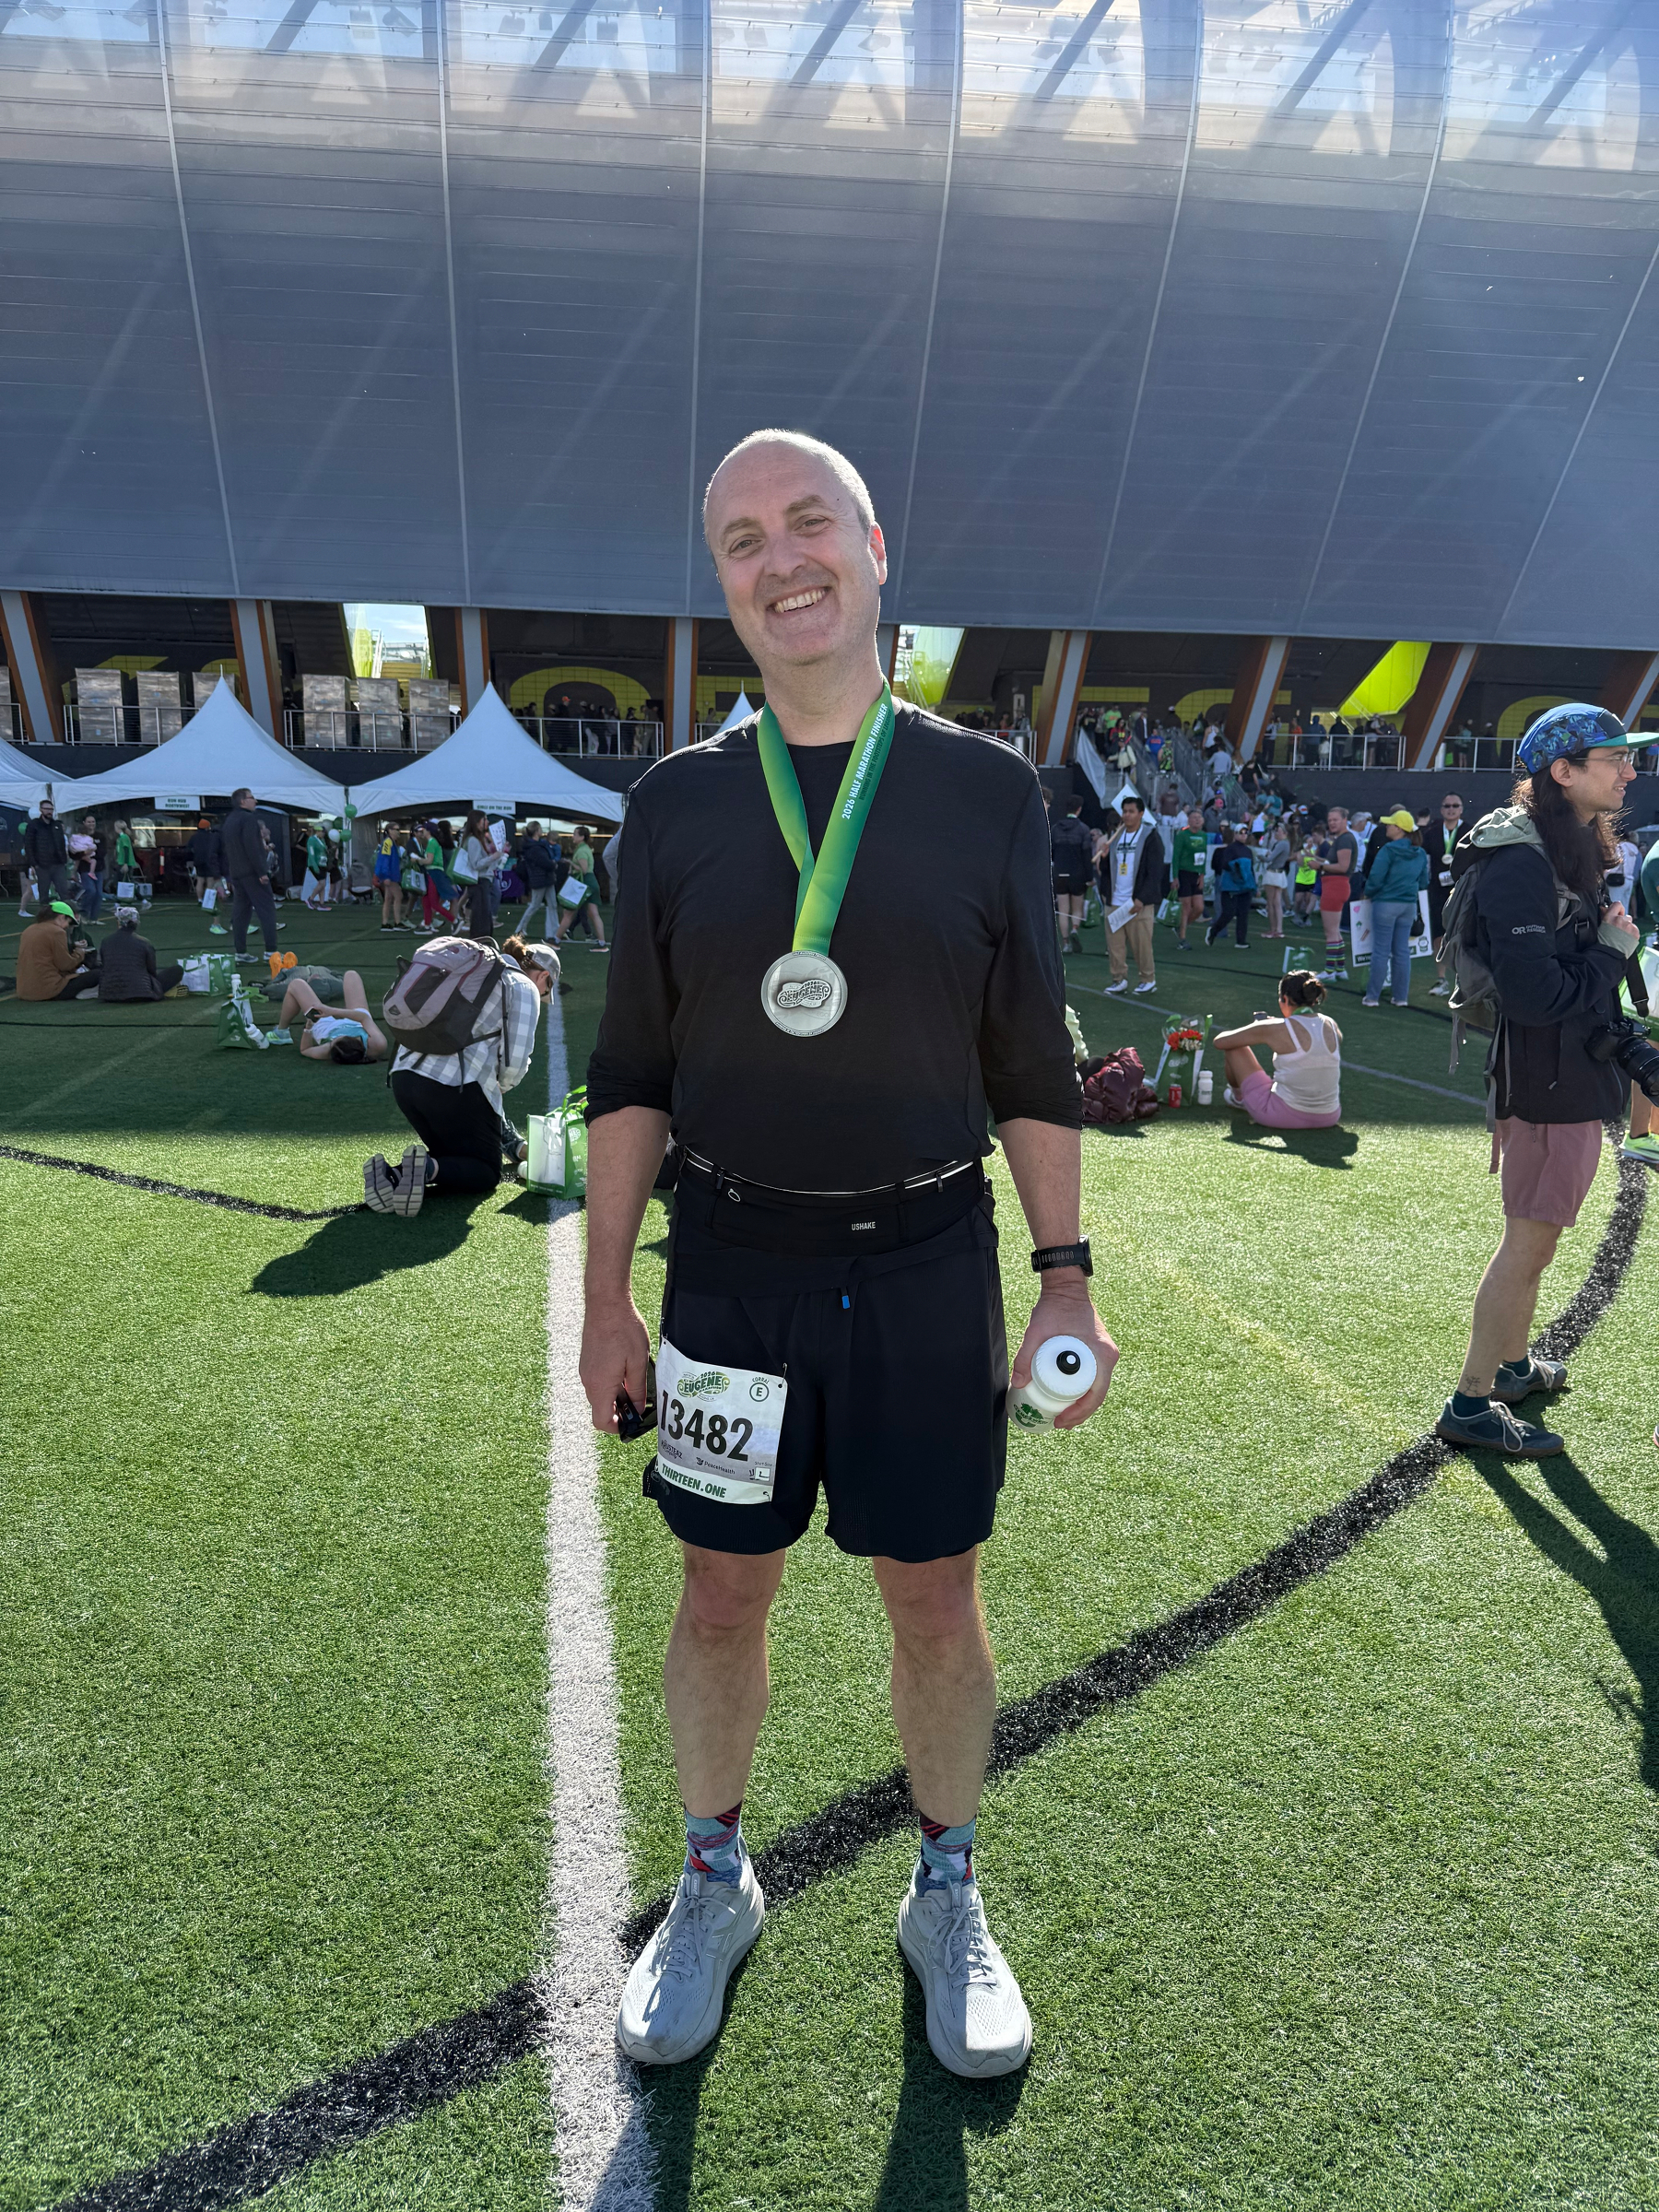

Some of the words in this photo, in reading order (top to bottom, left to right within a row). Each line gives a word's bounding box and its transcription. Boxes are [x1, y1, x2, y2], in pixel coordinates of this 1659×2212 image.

[870, 702, 888, 737] FINISHER
[855, 735, 877, 781] MARATHON
[849, 779, 862, 798] HALF
[841, 798, 855, 820] 2026
[1512, 926, 1527, 935] OR
[787, 984, 823, 1002] EUGENE
[851, 1221, 877, 1231] USHAKE
[700, 1371, 716, 1379] 2026
[751, 1376, 770, 1384] CORRAL
[684, 1376, 723, 1394] EUGENE
[756, 1386, 763, 1396] E
[660, 1389, 754, 1462] 13482
[704, 1461, 735, 1475] PeaceHealth
[662, 1463, 727, 1499] THIRTEEN.ONE
